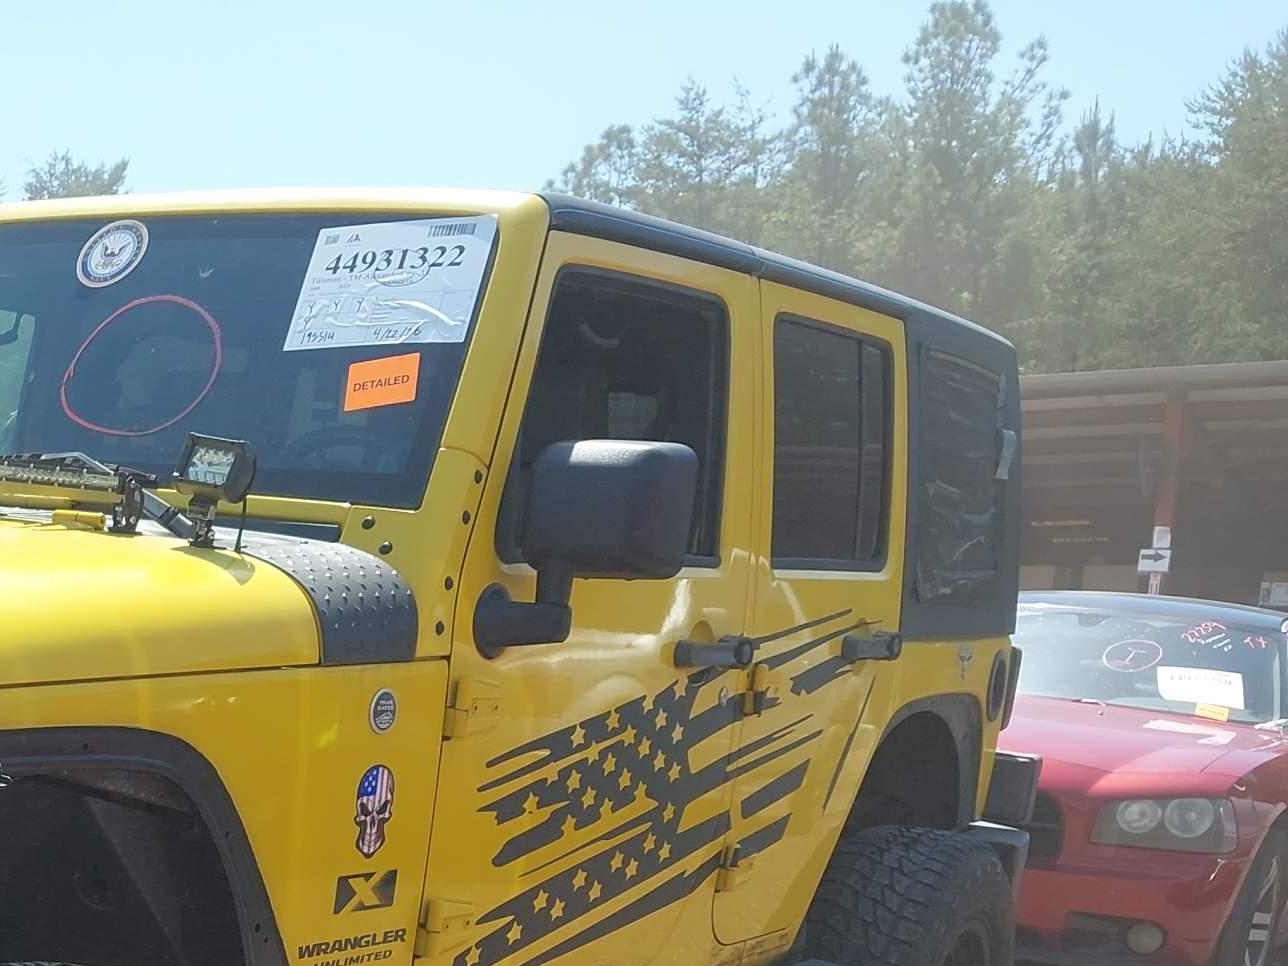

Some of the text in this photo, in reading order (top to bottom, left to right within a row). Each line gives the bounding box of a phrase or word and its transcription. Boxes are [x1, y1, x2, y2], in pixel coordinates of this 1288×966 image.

[325, 245, 466, 275] 44931322
[353, 374, 410, 393] DETAILED
[297, 928, 407, 960] WRANGLER
